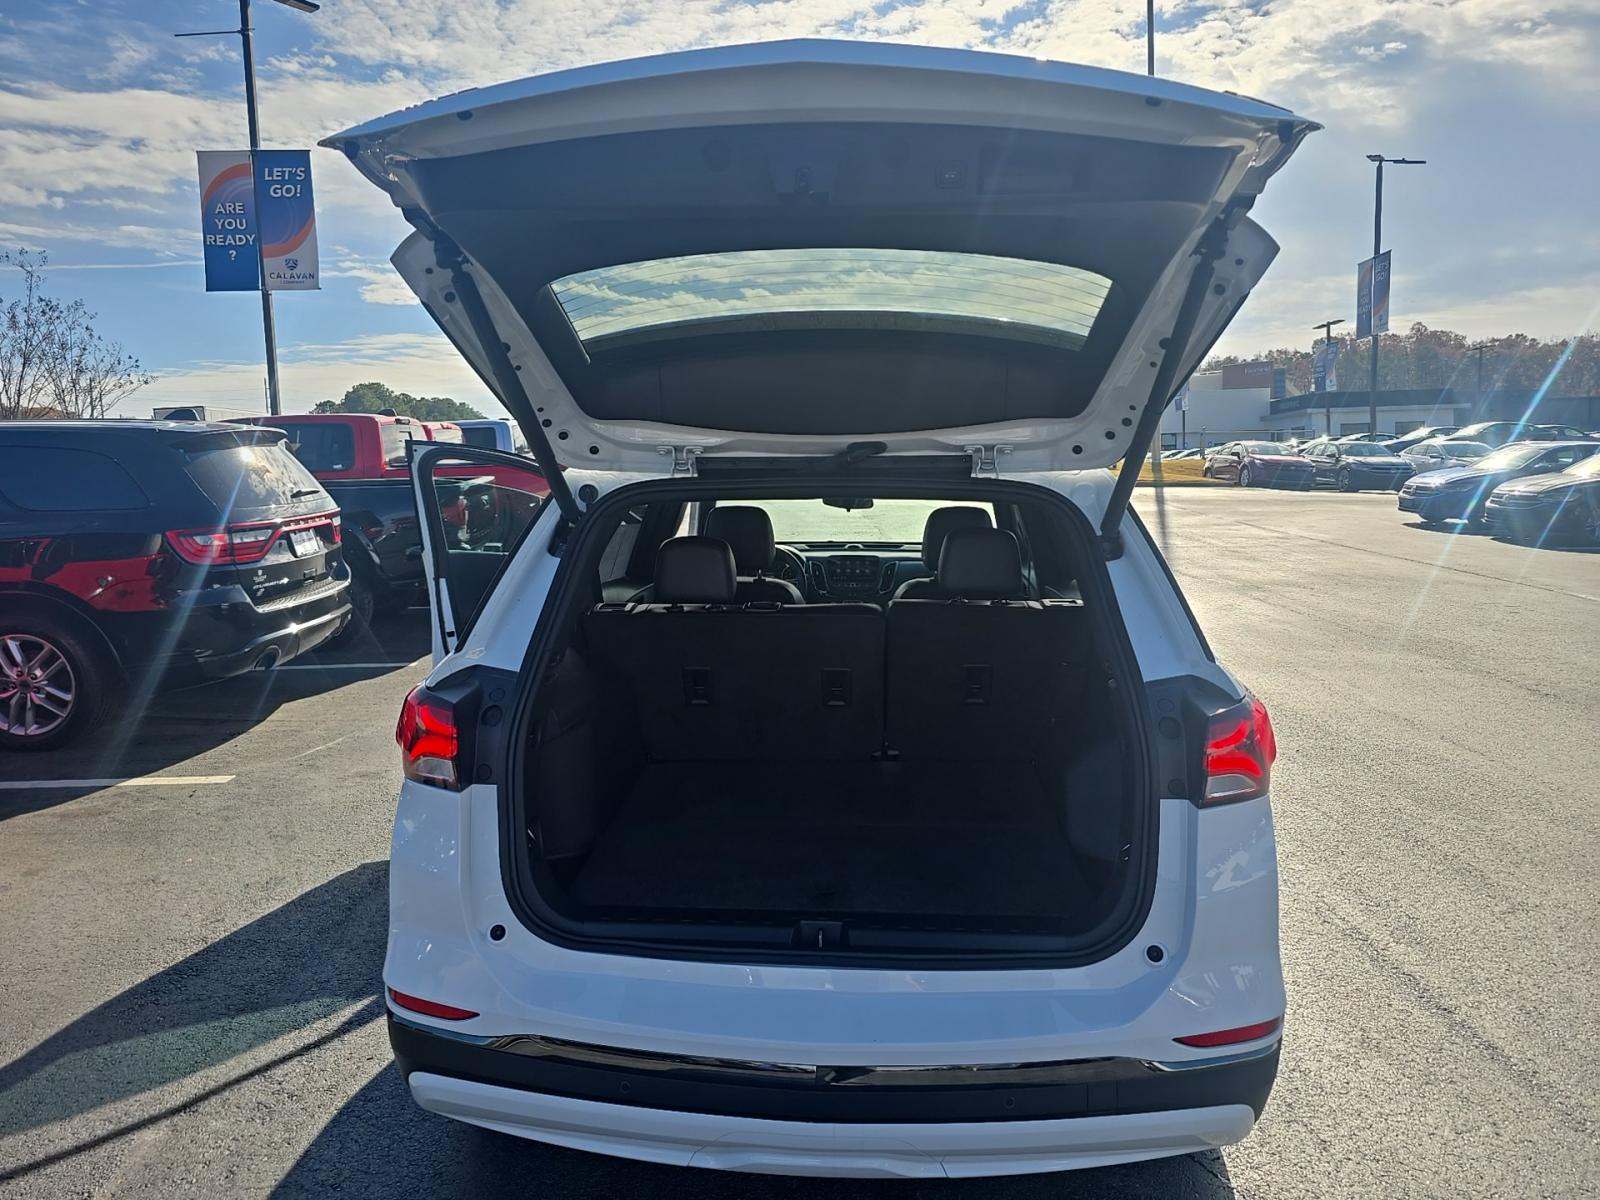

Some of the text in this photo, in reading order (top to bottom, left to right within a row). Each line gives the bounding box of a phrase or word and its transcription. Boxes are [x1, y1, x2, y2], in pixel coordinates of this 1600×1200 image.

[264, 167, 306, 181] LET'S
[269, 184, 301, 197] GO!
[214, 202, 245, 214] ARE
[214, 218, 247, 230] YOU
[206, 234, 256, 245] READY
[228, 249, 237, 261] ?
[269, 271, 315, 280] CALAVAN
